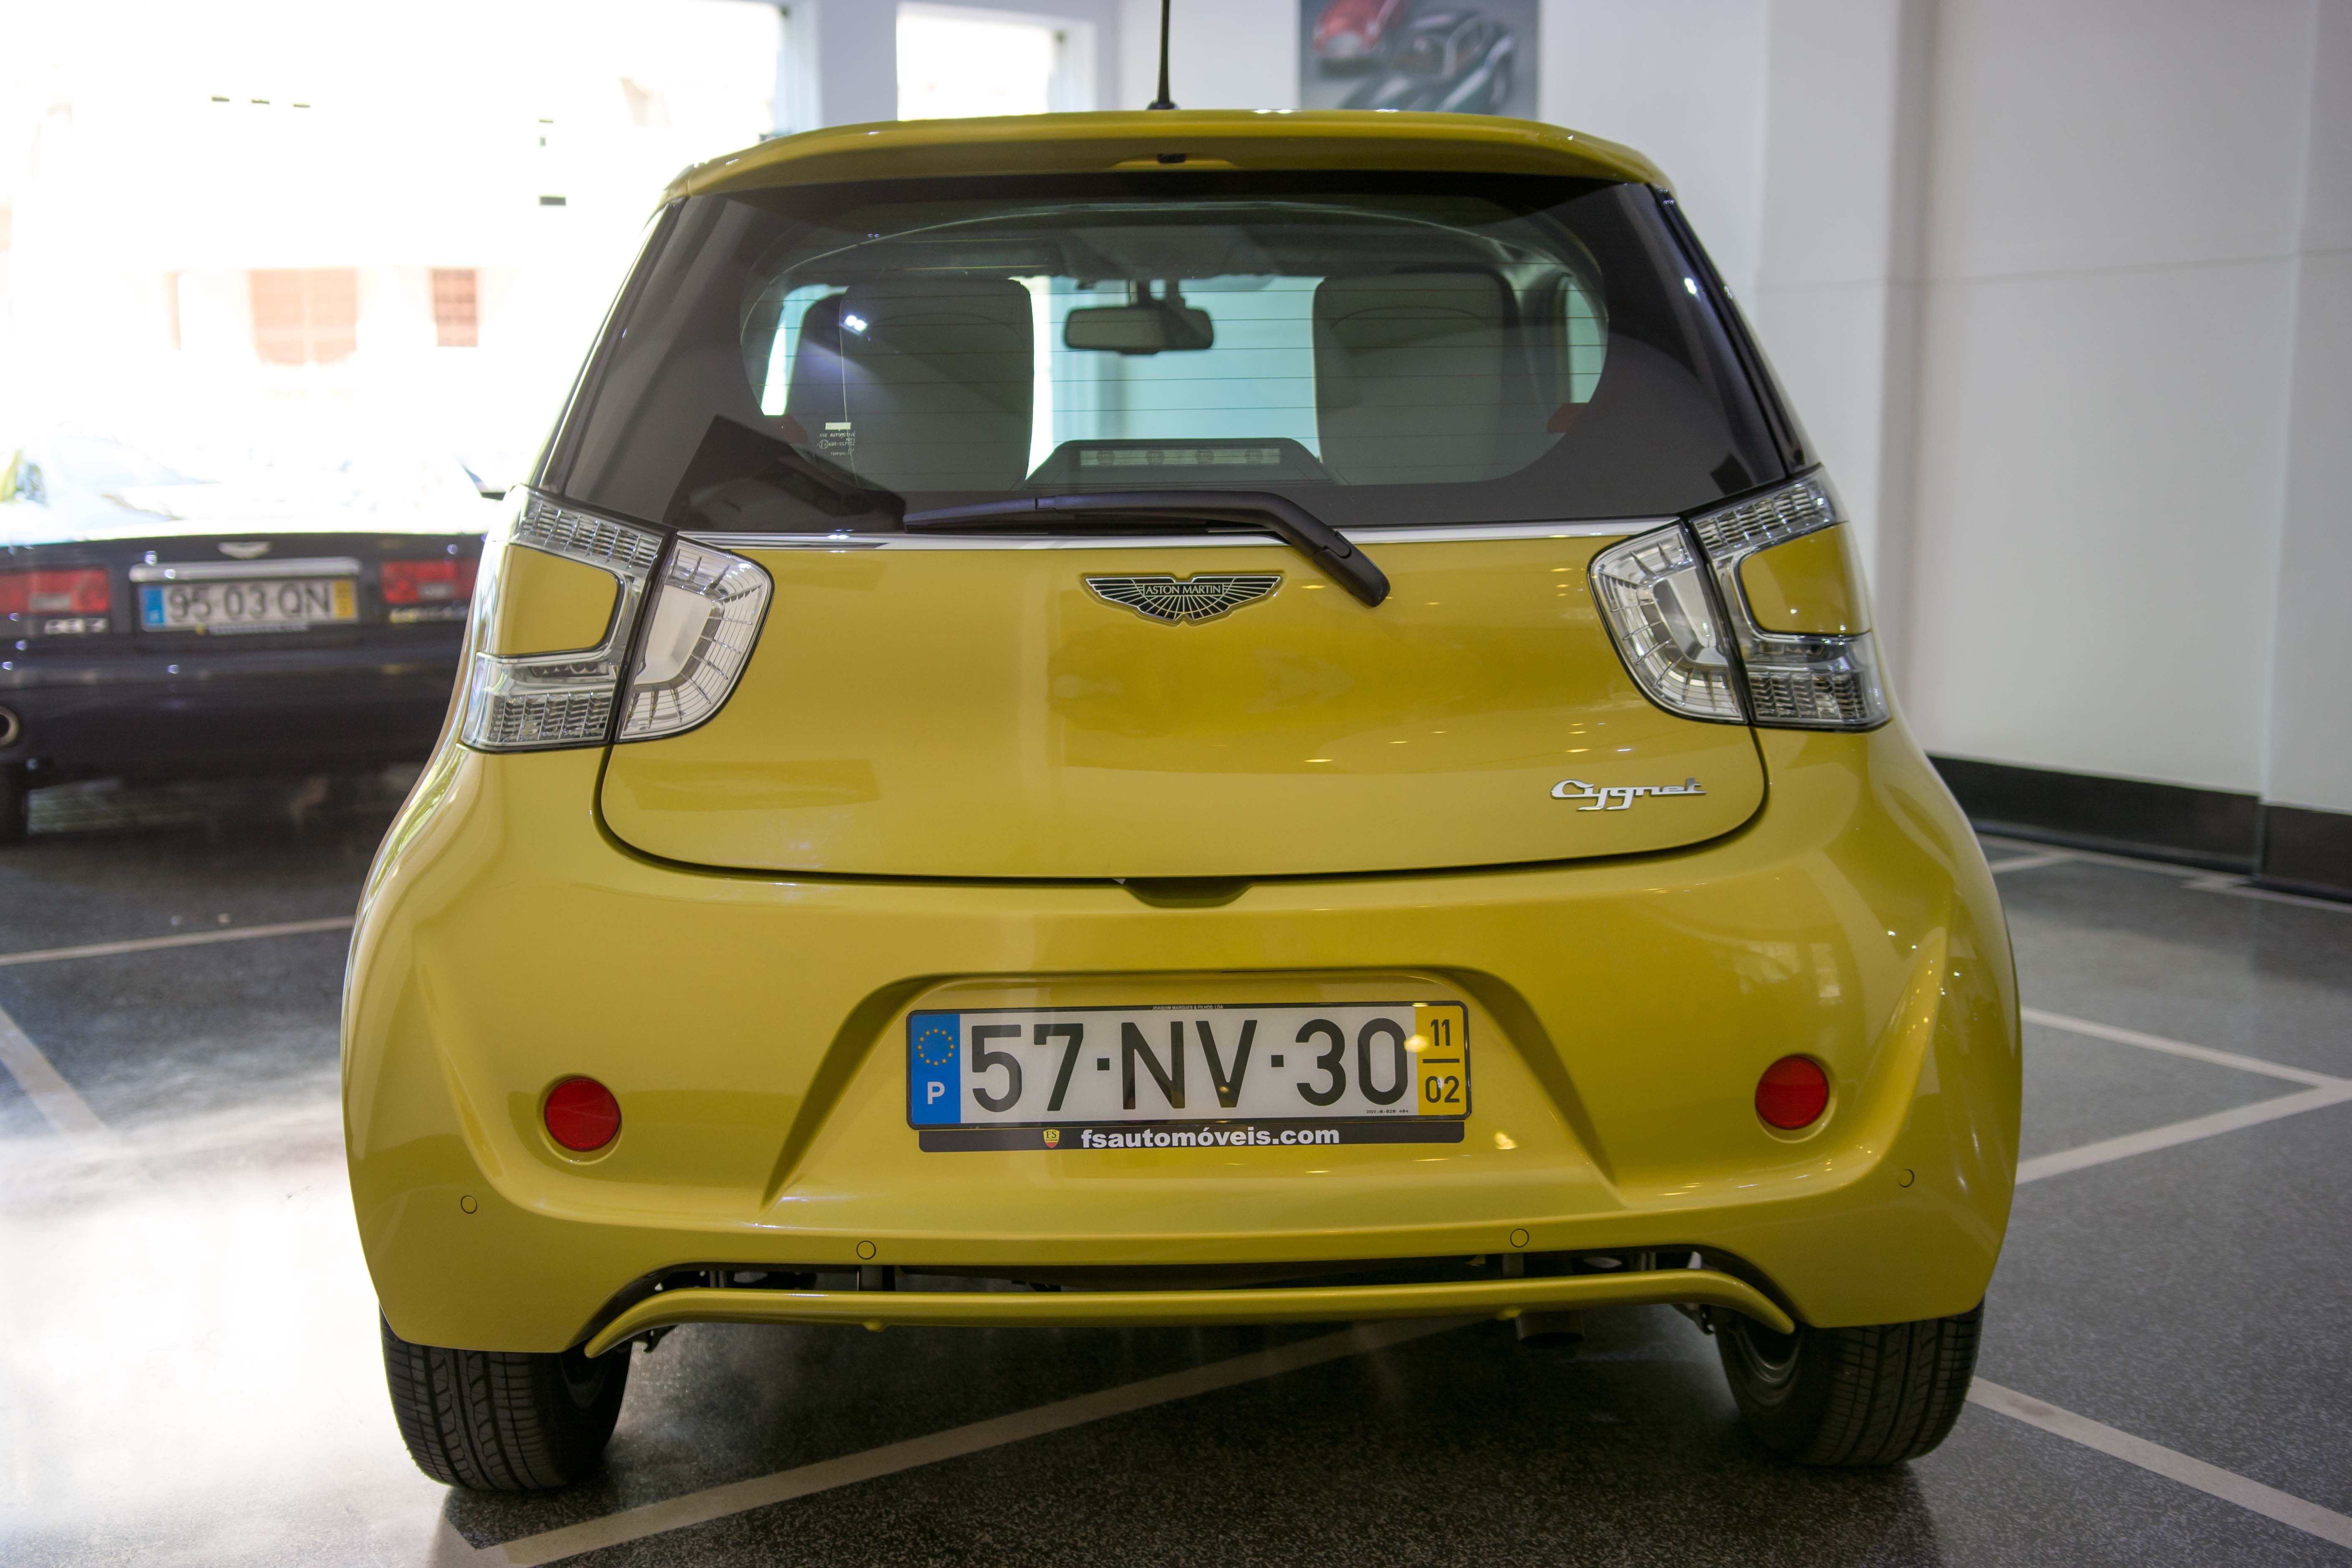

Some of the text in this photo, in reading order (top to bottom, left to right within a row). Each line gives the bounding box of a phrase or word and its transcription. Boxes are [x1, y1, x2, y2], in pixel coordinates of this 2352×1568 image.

[1146, 584, 1221, 595] ASTON MARTIN
[1551, 777, 1707, 811] Cygnet
[1430, 1019, 1451, 1046] 11
[927, 1081, 945, 1105] P
[1425, 1075, 1460, 1103] 02
[1081, 1126, 1340, 1149] fsautomóveis.com
